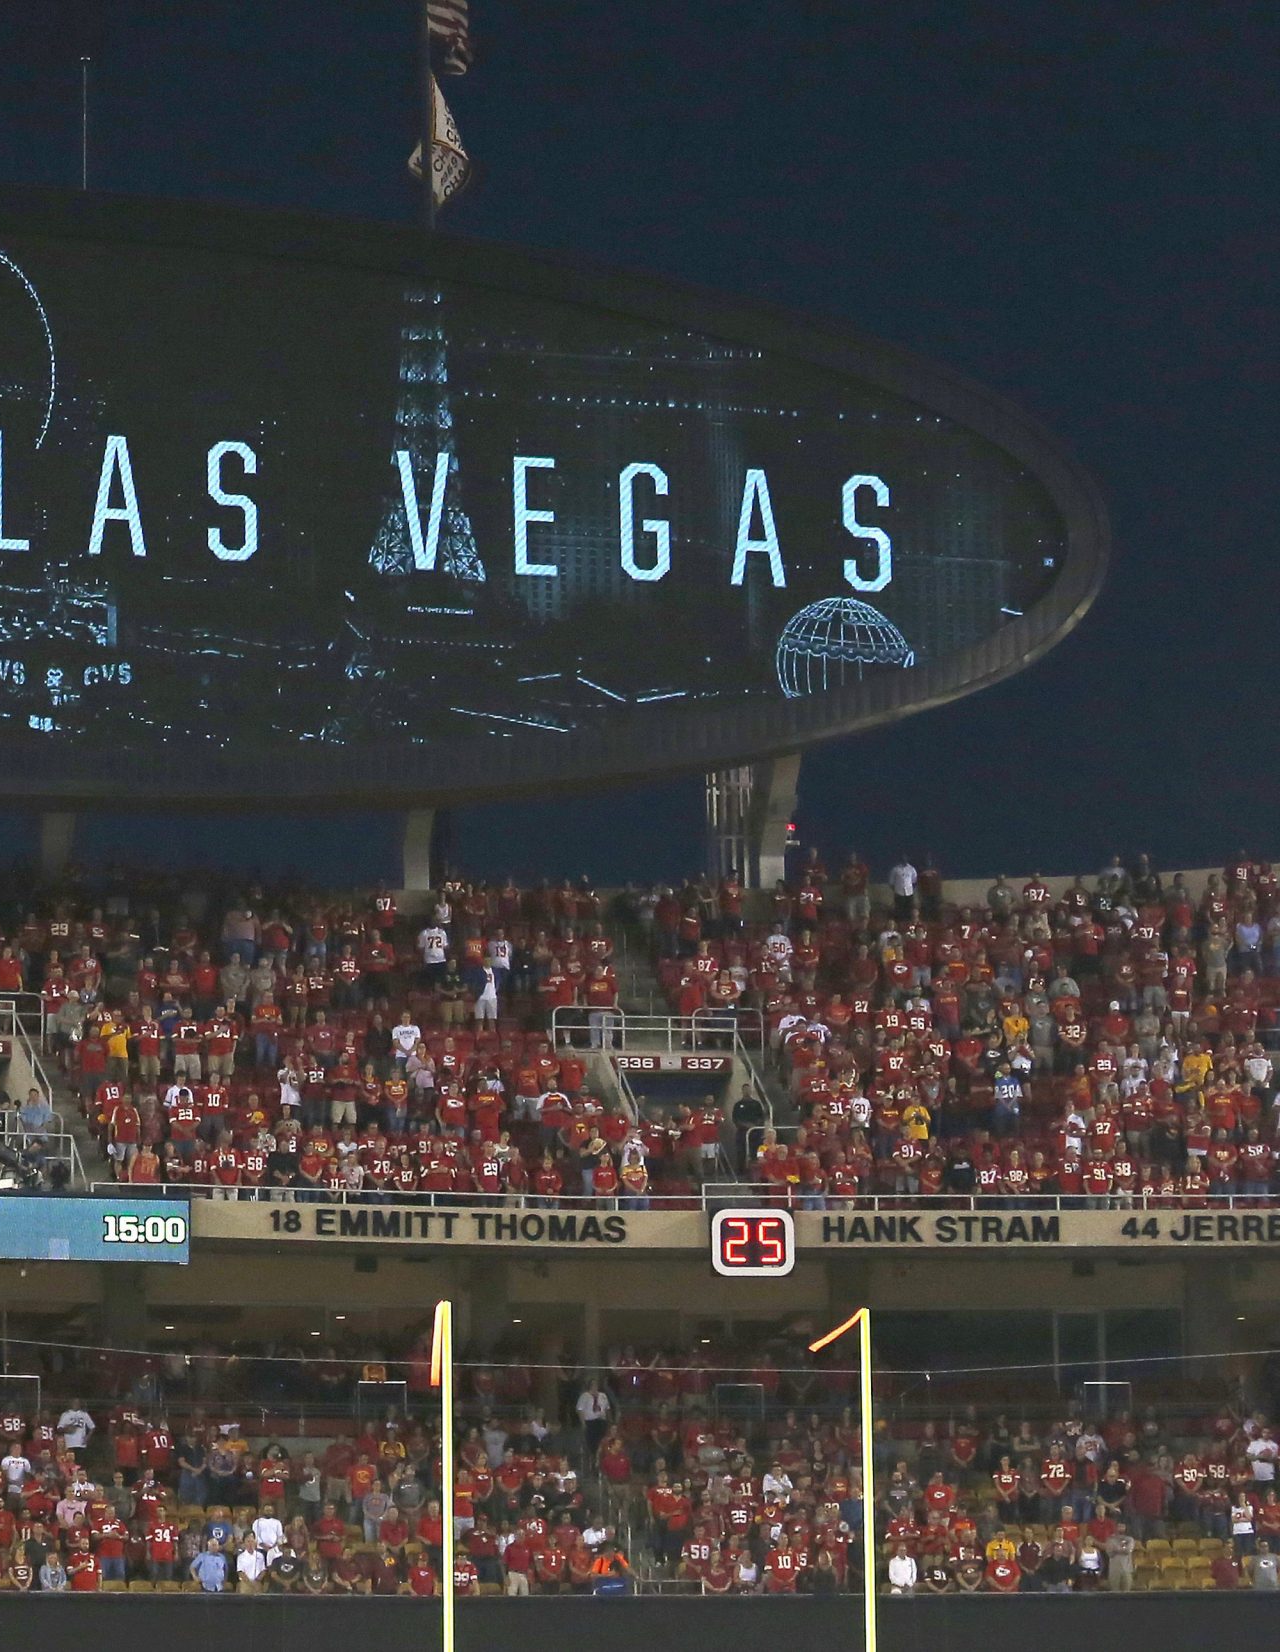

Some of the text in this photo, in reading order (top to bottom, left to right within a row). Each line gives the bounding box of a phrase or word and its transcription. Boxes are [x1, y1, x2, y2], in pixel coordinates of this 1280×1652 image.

[396, 450, 892, 592] VEGAS
[83, 662, 132, 686] CVS
[1029, 889, 1044, 901] 87
[962, 925, 970, 939] 7
[1139, 928, 1153, 939] 37
[428, 937, 442, 949] 72
[341, 961, 355, 972] 29
[697, 959, 712, 972] 87
[855, 1001, 867, 1013] 27
[886, 1014, 899, 1027] 19
[910, 1017, 925, 1030] 56
[1066, 1025, 1080, 1038] 32
[617, 1057, 654, 1069] 336
[687, 1059, 724, 1070] 337
[889, 1057, 903, 1070] 87
[1097, 1059, 1111, 1071] 29
[105, 1087, 119, 1099] 19
[207, 1093, 220, 1107] 10
[830, 1102, 843, 1115] 31
[854, 1103, 866, 1115] 31
[1095, 1123, 1110, 1135] 27
[419, 1141, 432, 1154] 91
[901, 1144, 914, 1158] 91
[247, 1157, 263, 1171] 58
[373, 1160, 391, 1174] 78
[483, 1162, 500, 1177] 29
[401, 1170, 414, 1182] 87
[980, 1170, 996, 1184] 87
[1094, 1169, 1106, 1181] 91
[103, 1215, 187, 1243] 15:00
[270, 1208, 627, 1243] 18 EMMITT THOMAS
[822, 1216, 1061, 1243] HANK STRAM
[1121, 1216, 1160, 1240] 44
[726, 1220, 782, 1263] 25
[4, 1418, 20, 1432] 58
[153, 1434, 168, 1448] 10
[1049, 1464, 1064, 1478] 72
[1183, 1469, 1197, 1482] 50
[740, 1482, 751, 1496] 11
[730, 1510, 747, 1524] 25
[154, 1530, 172, 1543] 34
[690, 1545, 709, 1559] 58
[777, 1556, 791, 1569] 10
[933, 1570, 947, 1581] 91
